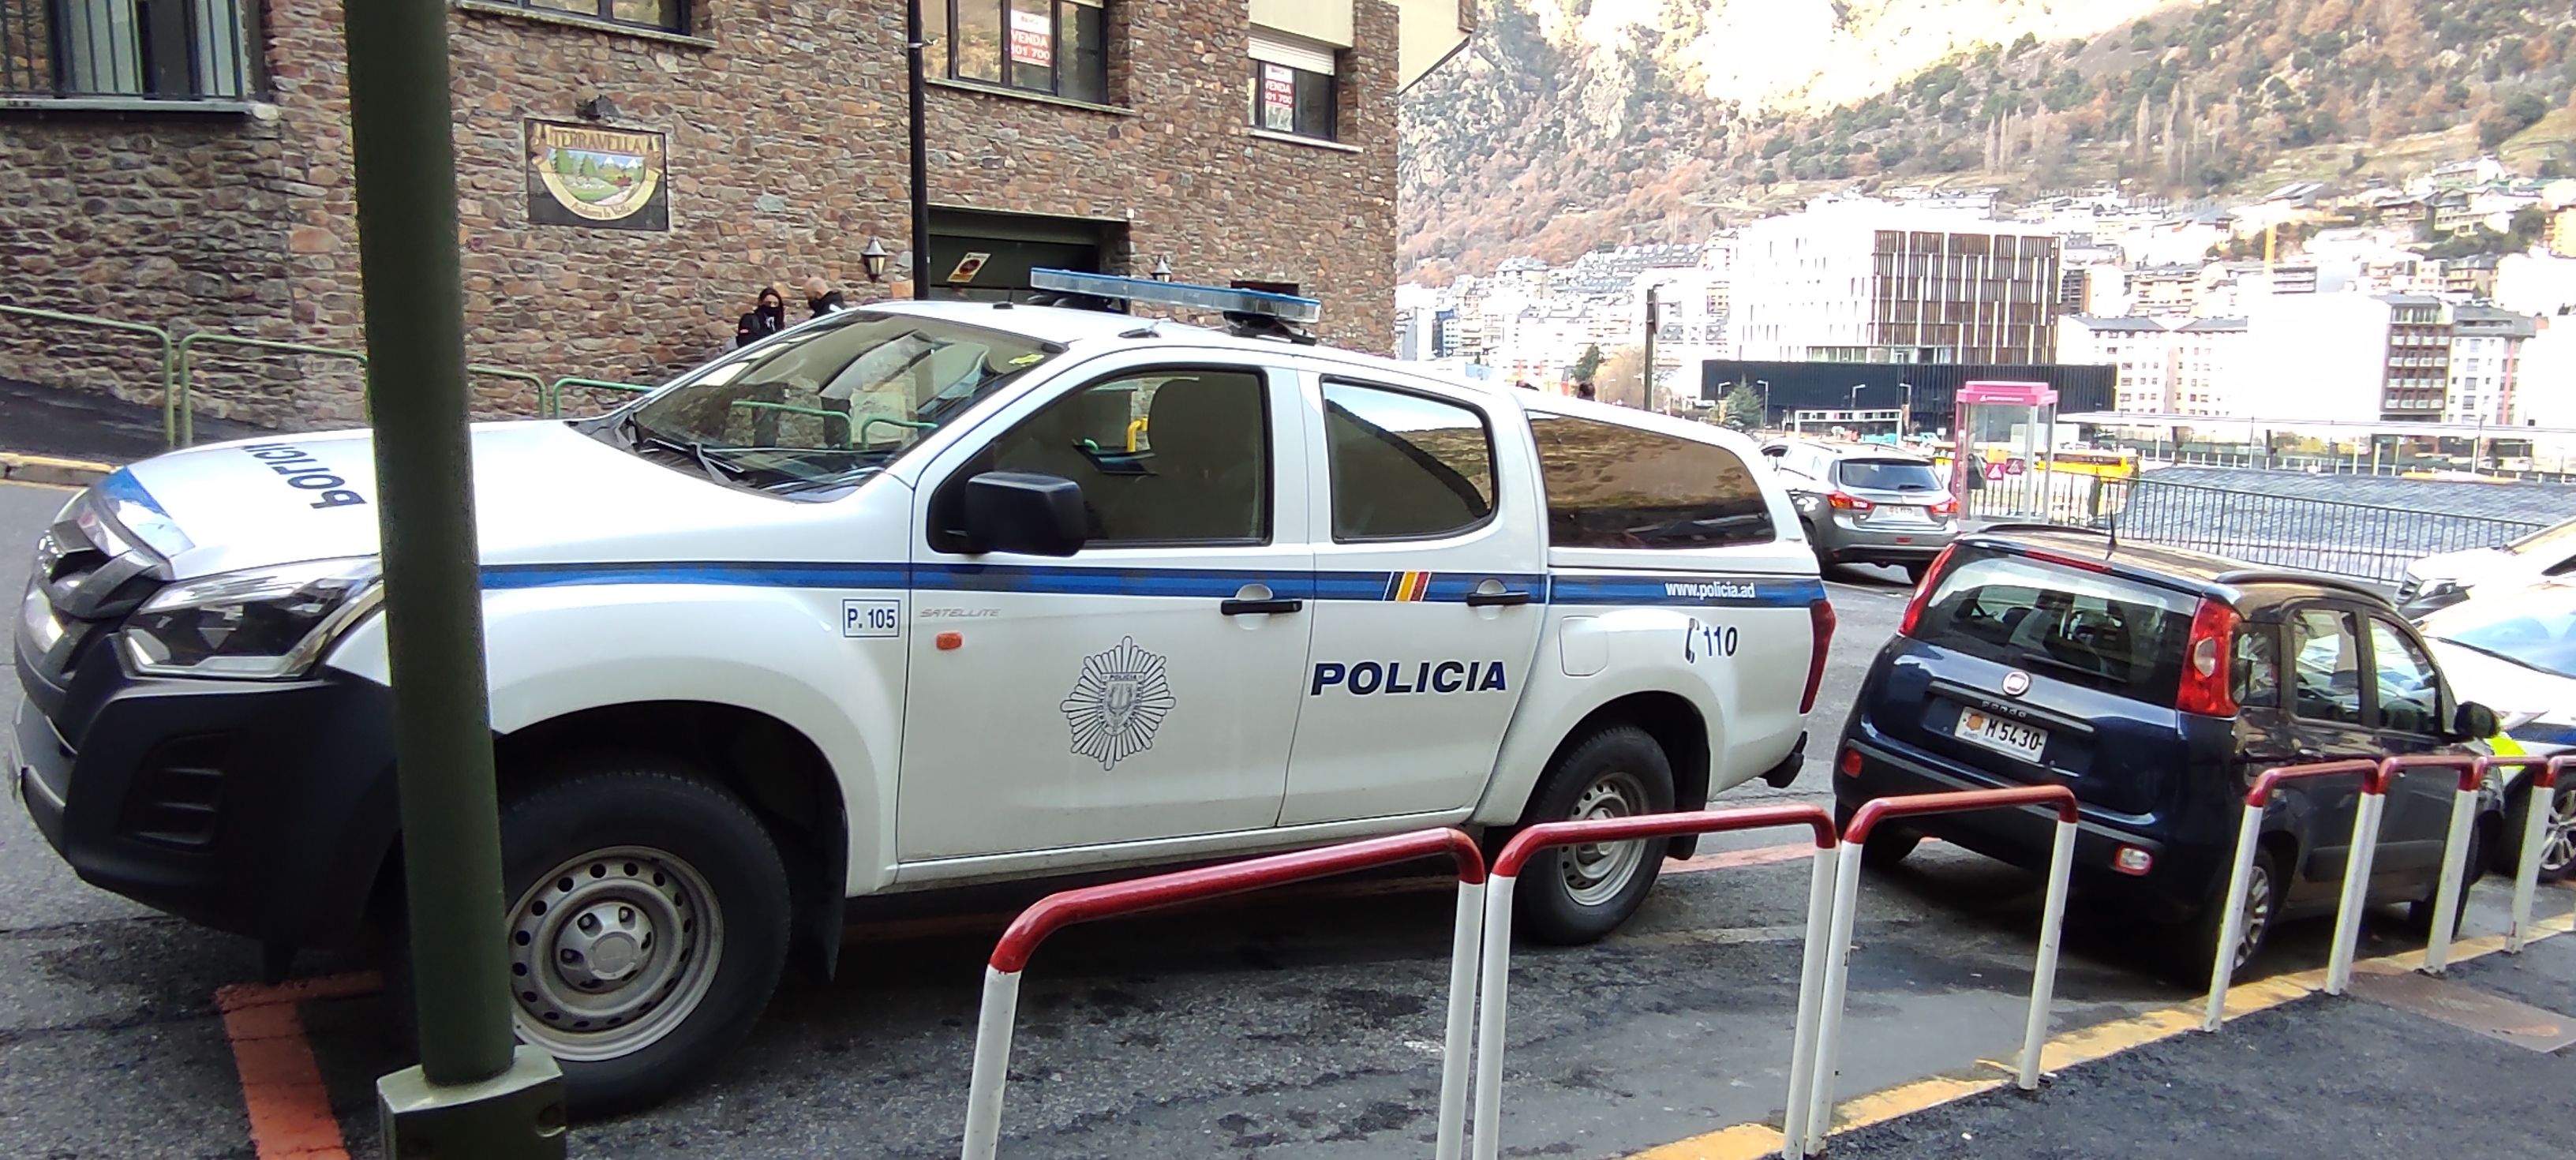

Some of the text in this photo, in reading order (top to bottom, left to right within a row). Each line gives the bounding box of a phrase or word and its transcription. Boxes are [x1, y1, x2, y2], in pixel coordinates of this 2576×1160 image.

[1664, 581, 1755, 601] www.policia.ad
[848, 608, 895, 628] P. 105
[920, 608, 1001, 618] SATELLITE
[1703, 626, 1738, 657] 110
[1311, 661, 1507, 696] POLICIA
[1985, 718, 1998, 739] M
[1998, 723, 2041, 750] 5430
